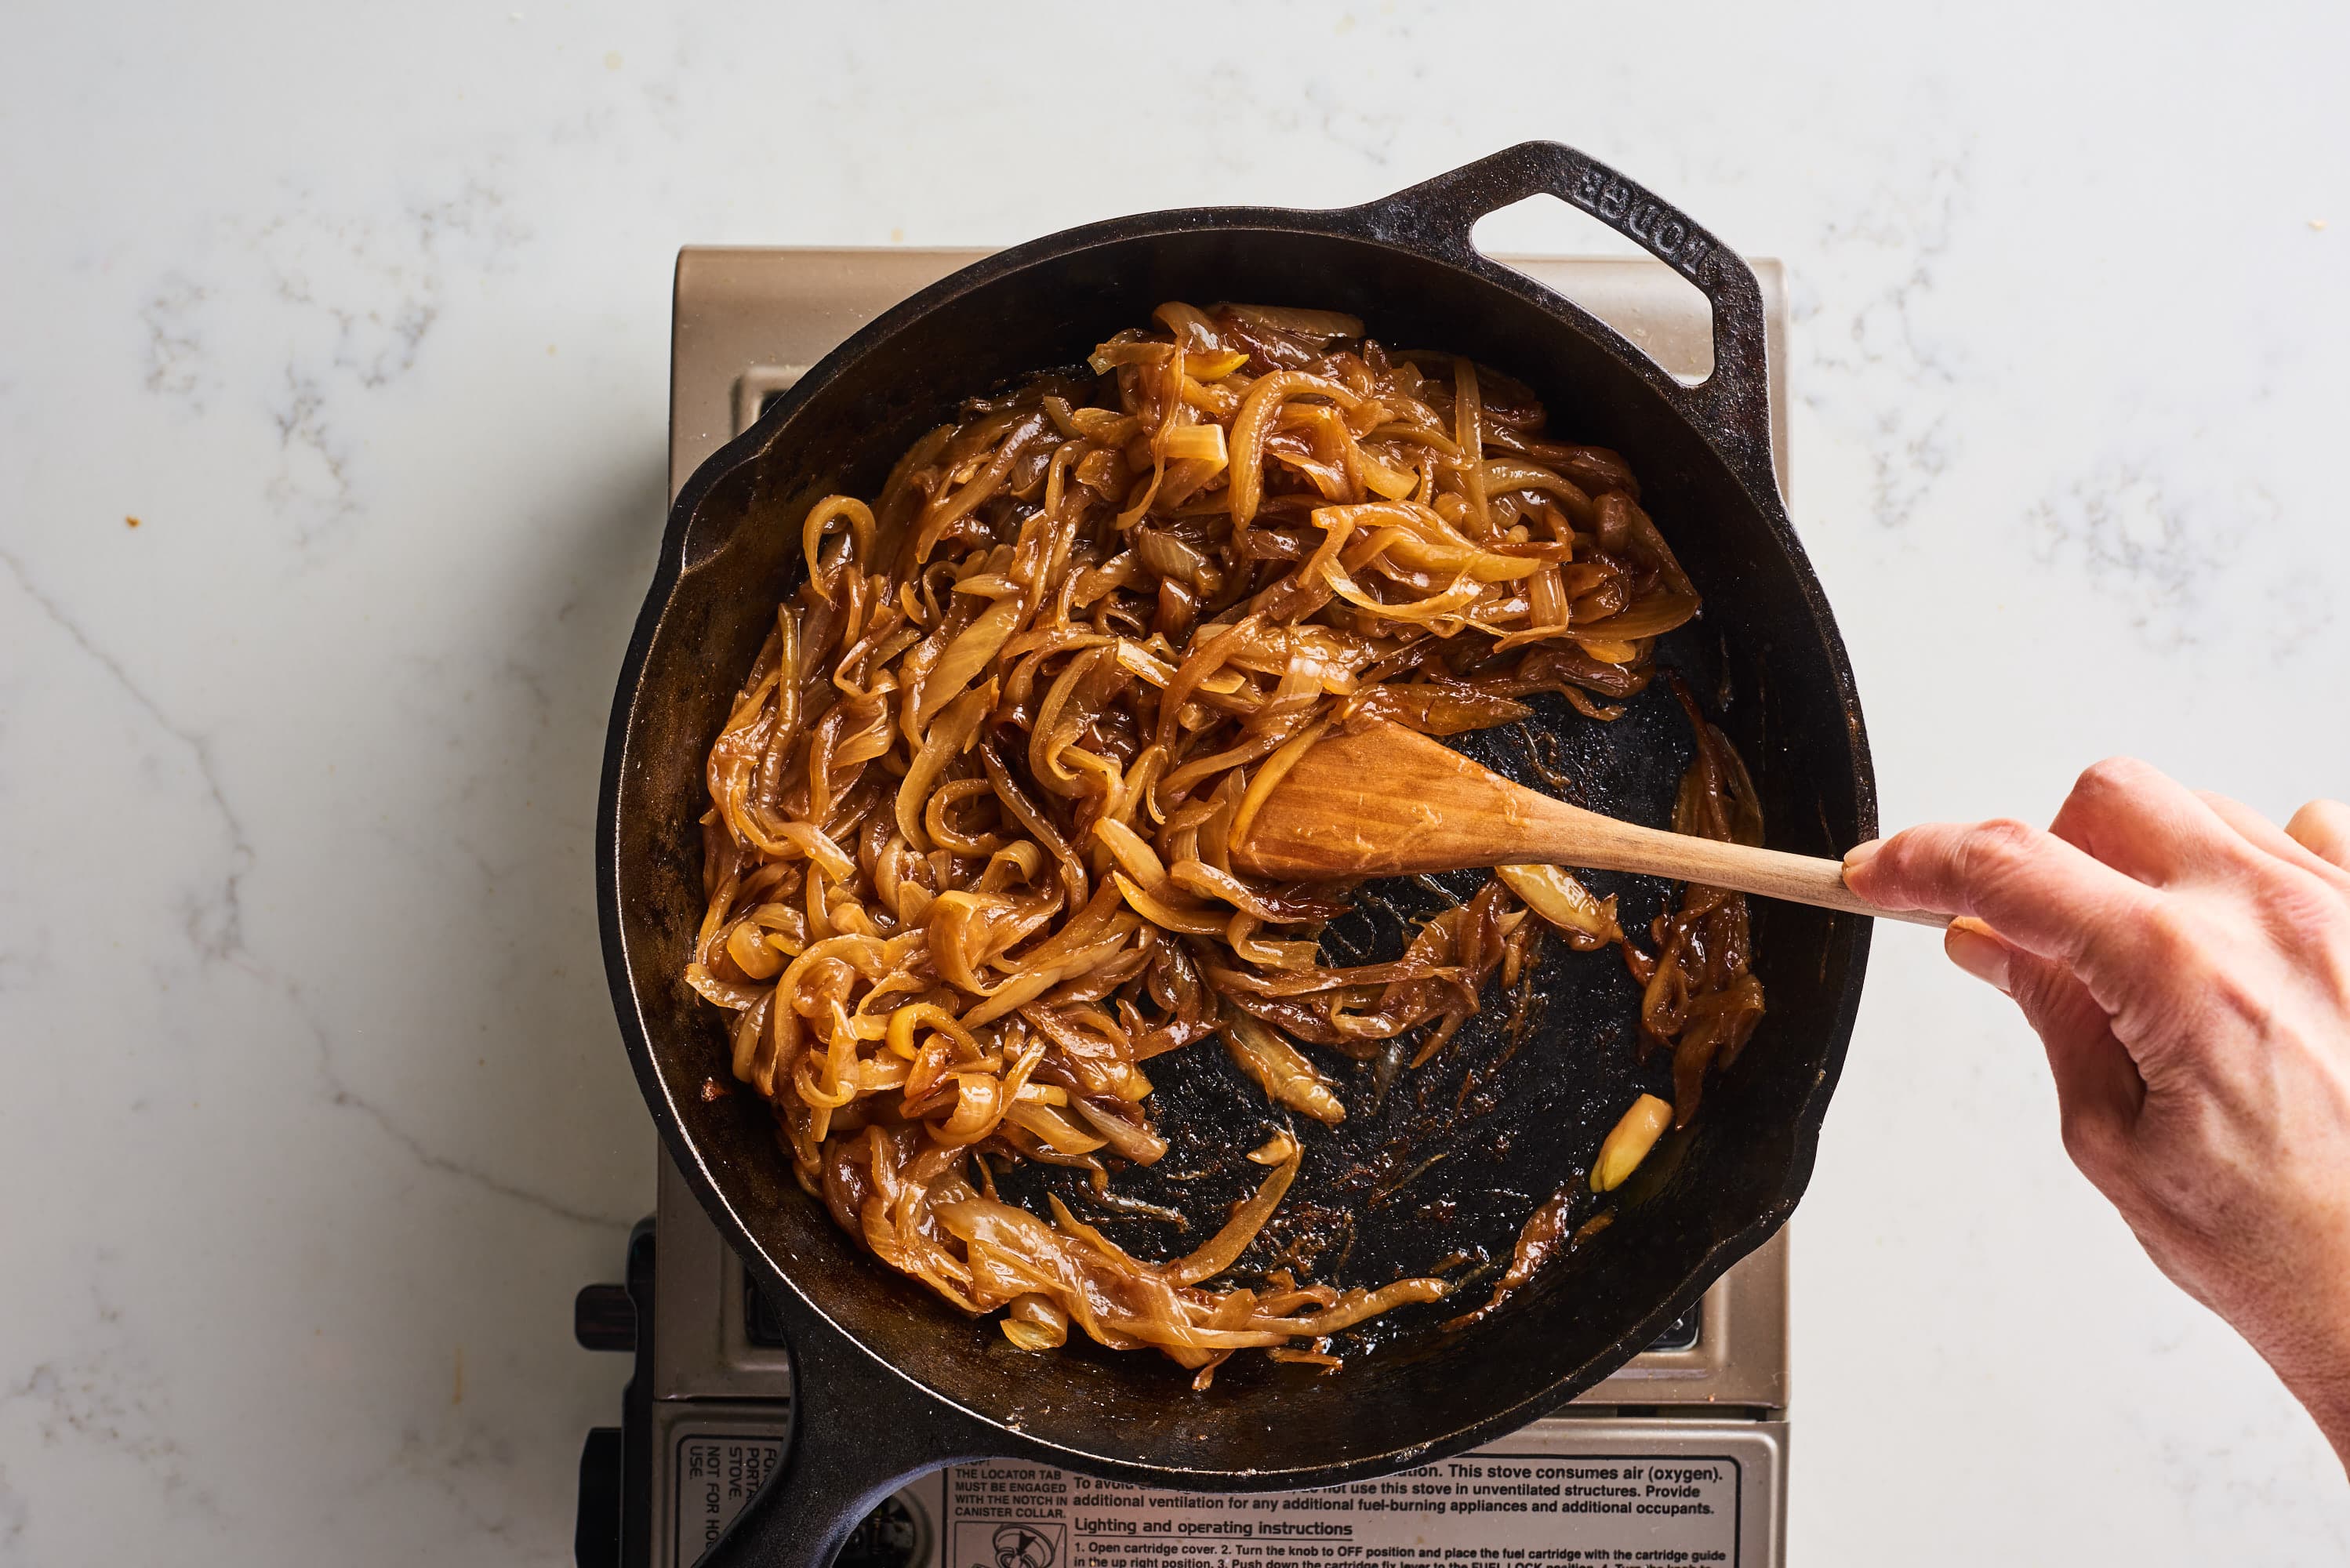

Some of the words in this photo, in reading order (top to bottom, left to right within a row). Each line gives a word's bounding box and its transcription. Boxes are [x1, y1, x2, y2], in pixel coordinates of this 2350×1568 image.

[1571, 161, 1715, 275] LODGE
[689, 1446, 703, 1480] USE.
[706, 1446, 721, 1478] NOT
[728, 1446, 743, 1501] STOVE.
[956, 1469, 977, 1479] THE
[982, 1469, 1036, 1480] LOCATOR
[1039, 1470, 1062, 1480] TAB
[1073, 1477, 1091, 1489] To
[1448, 1464, 1482, 1478] This
[1487, 1465, 1531, 1478] stove
[1536, 1467, 1618, 1479] consumes
[1623, 1466, 1644, 1479] air
[1648, 1466, 1723, 1483] (oxygen).
[955, 1483, 986, 1492] MUST
[991, 1483, 1006, 1492] BE
[1010, 1483, 1066, 1493] ENGAGED
[1351, 1484, 1377, 1494] use
[1381, 1483, 1407, 1494] this
[1412, 1483, 1451, 1494] stove
[1456, 1483, 1469, 1494] in
[1473, 1483, 1560, 1495] unventilated
[1564, 1485, 1641, 1497] structures.
[1645, 1485, 1701, 1497] Provide
[706, 1483, 719, 1513] FOR
[955, 1495, 983, 1504] WITH
[986, 1495, 1009, 1504] THE
[1012, 1495, 1052, 1505] NOTCH
[1056, 1496, 1067, 1505] IN
[1073, 1494, 1144, 1507] additional
[1150, 1496, 1223, 1508] ventilation
[1229, 1497, 1248, 1508] for
[1252, 1499, 1279, 1512] any
[1283, 1497, 1353, 1510] additional
[1358, 1498, 1446, 1514] fuel-burning
[1450, 1500, 1527, 1514] appliances
[1531, 1501, 1557, 1512] and
[1561, 1501, 1632, 1513] additional
[1636, 1503, 1715, 1516] occupants.
[955, 1507, 1012, 1517] CANISTER
[1016, 1508, 1066, 1518] COLLAR.
[1074, 1517, 1136, 1534] Lighting
[1142, 1519, 1171, 1533] and
[1178, 1520, 1253, 1537] operating
[1259, 1522, 1353, 1535] instructions
[1074, 1542, 1085, 1552] 1.
[1088, 1541, 1121, 1555] Open
[1124, 1543, 1179, 1556] cartridge
[1183, 1545, 1218, 1555] cover.
[1221, 1544, 1232, 1555] 2.
[1236, 1544, 1262, 1555] Turn
[1266, 1545, 1285, 1555] the
[1289, 1546, 1319, 1556] knob
[1322, 1547, 1334, 1556] to
[1337, 1546, 1363, 1556] OFF
[1366, 1547, 1415, 1559] position
[1418, 1547, 1441, 1558] and
[1444, 1548, 1477, 1560] place
[1480, 1548, 1500, 1559] the
[1502, 1548, 1525, 1559] fuel
[1528, 1548, 1582, 1562] cartridge
[1584, 1548, 1610, 1559] with
[1614, 1549, 1633, 1559] the
[1635, 1550, 1688, 1563] cartridge
[1691, 1551, 1726, 1563] guide
[1074, 1556, 1085, 1567] in
[1111, 1559, 1127, 1568] up
[1130, 1557, 1159, 1568] right
[1161, 1557, 1213, 1568] position.
[1232, 1559, 1262, 1568] Push
